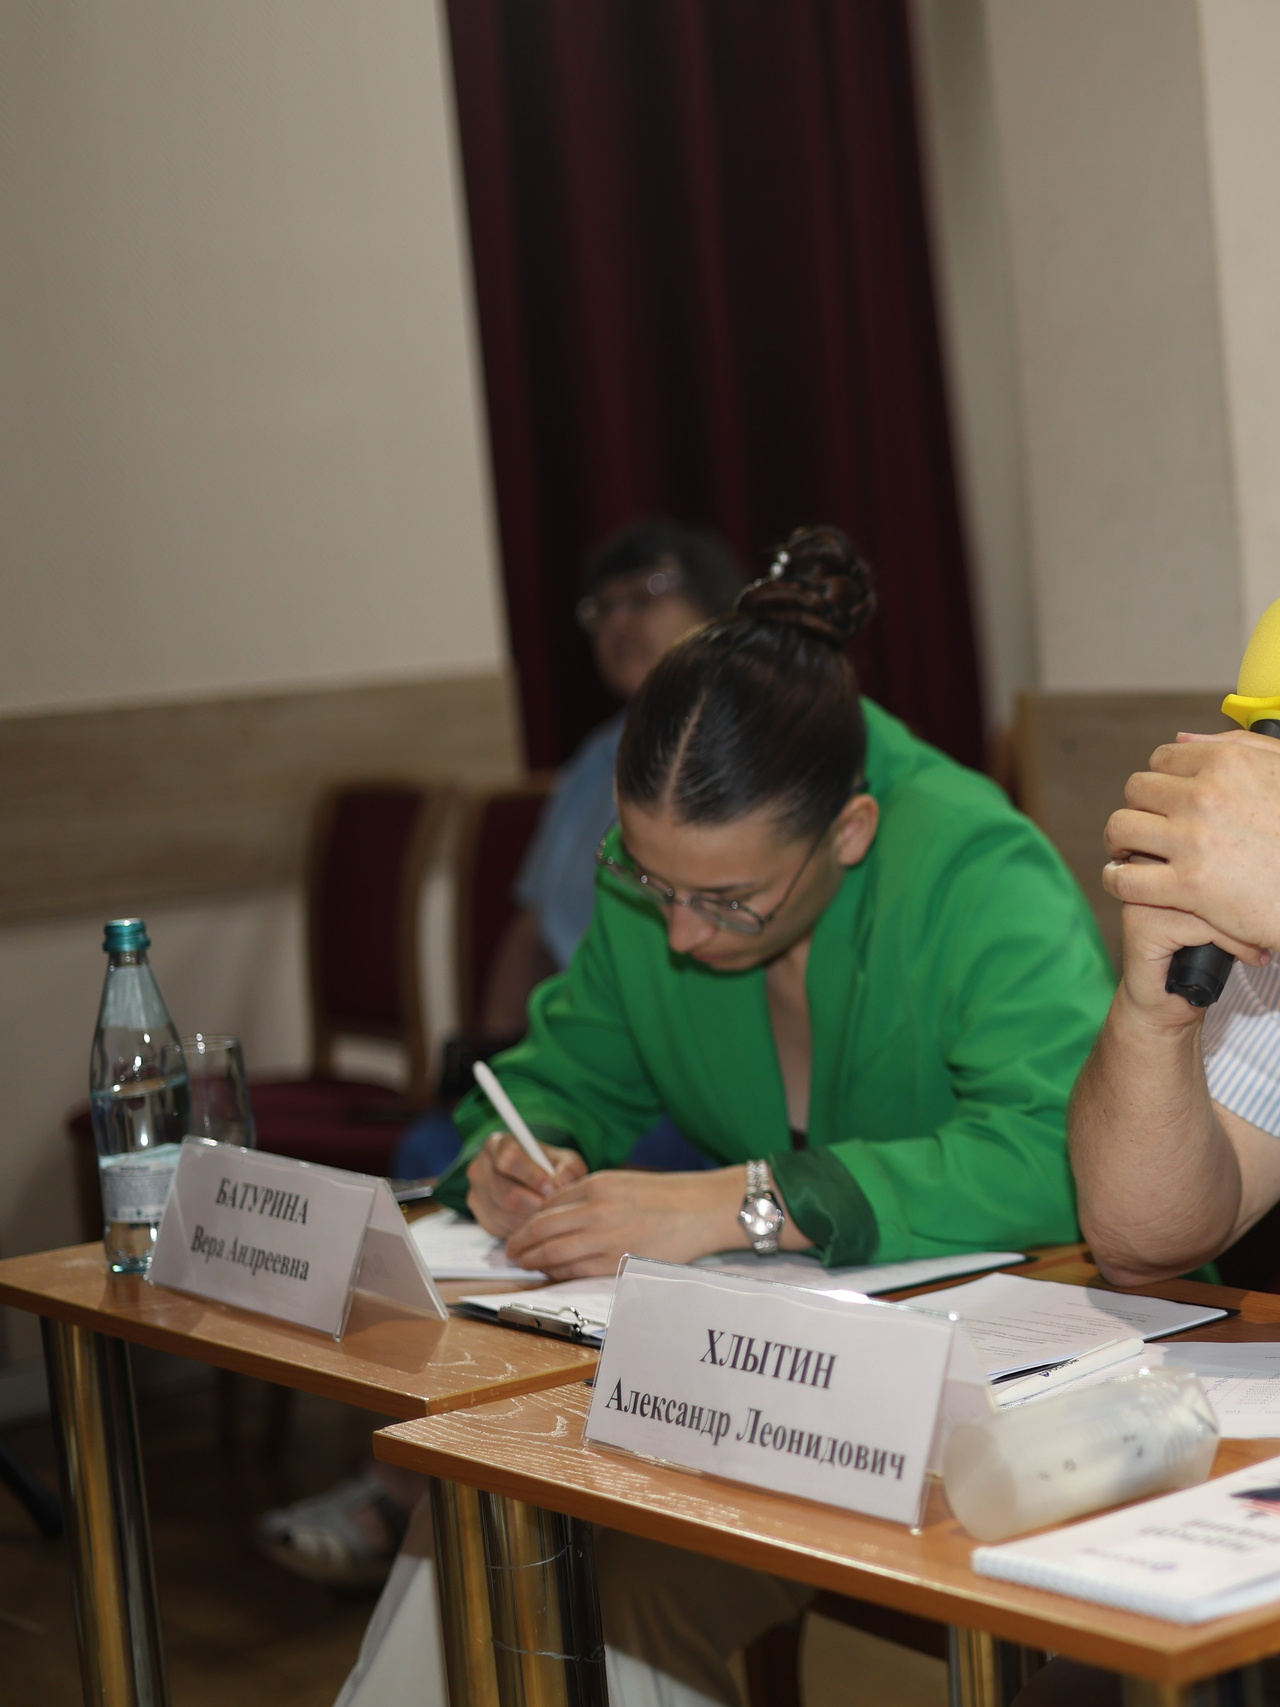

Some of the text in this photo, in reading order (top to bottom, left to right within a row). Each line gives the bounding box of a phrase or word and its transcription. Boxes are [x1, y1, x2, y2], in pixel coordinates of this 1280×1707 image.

[215, 1177, 309, 1225] БАТУРИНА
[190, 1224, 310, 1281] Вера Андреевна
[699, 1328, 837, 1390] ХЛЫТИН
[605, 1377, 906, 1480] Александр Леонидович
